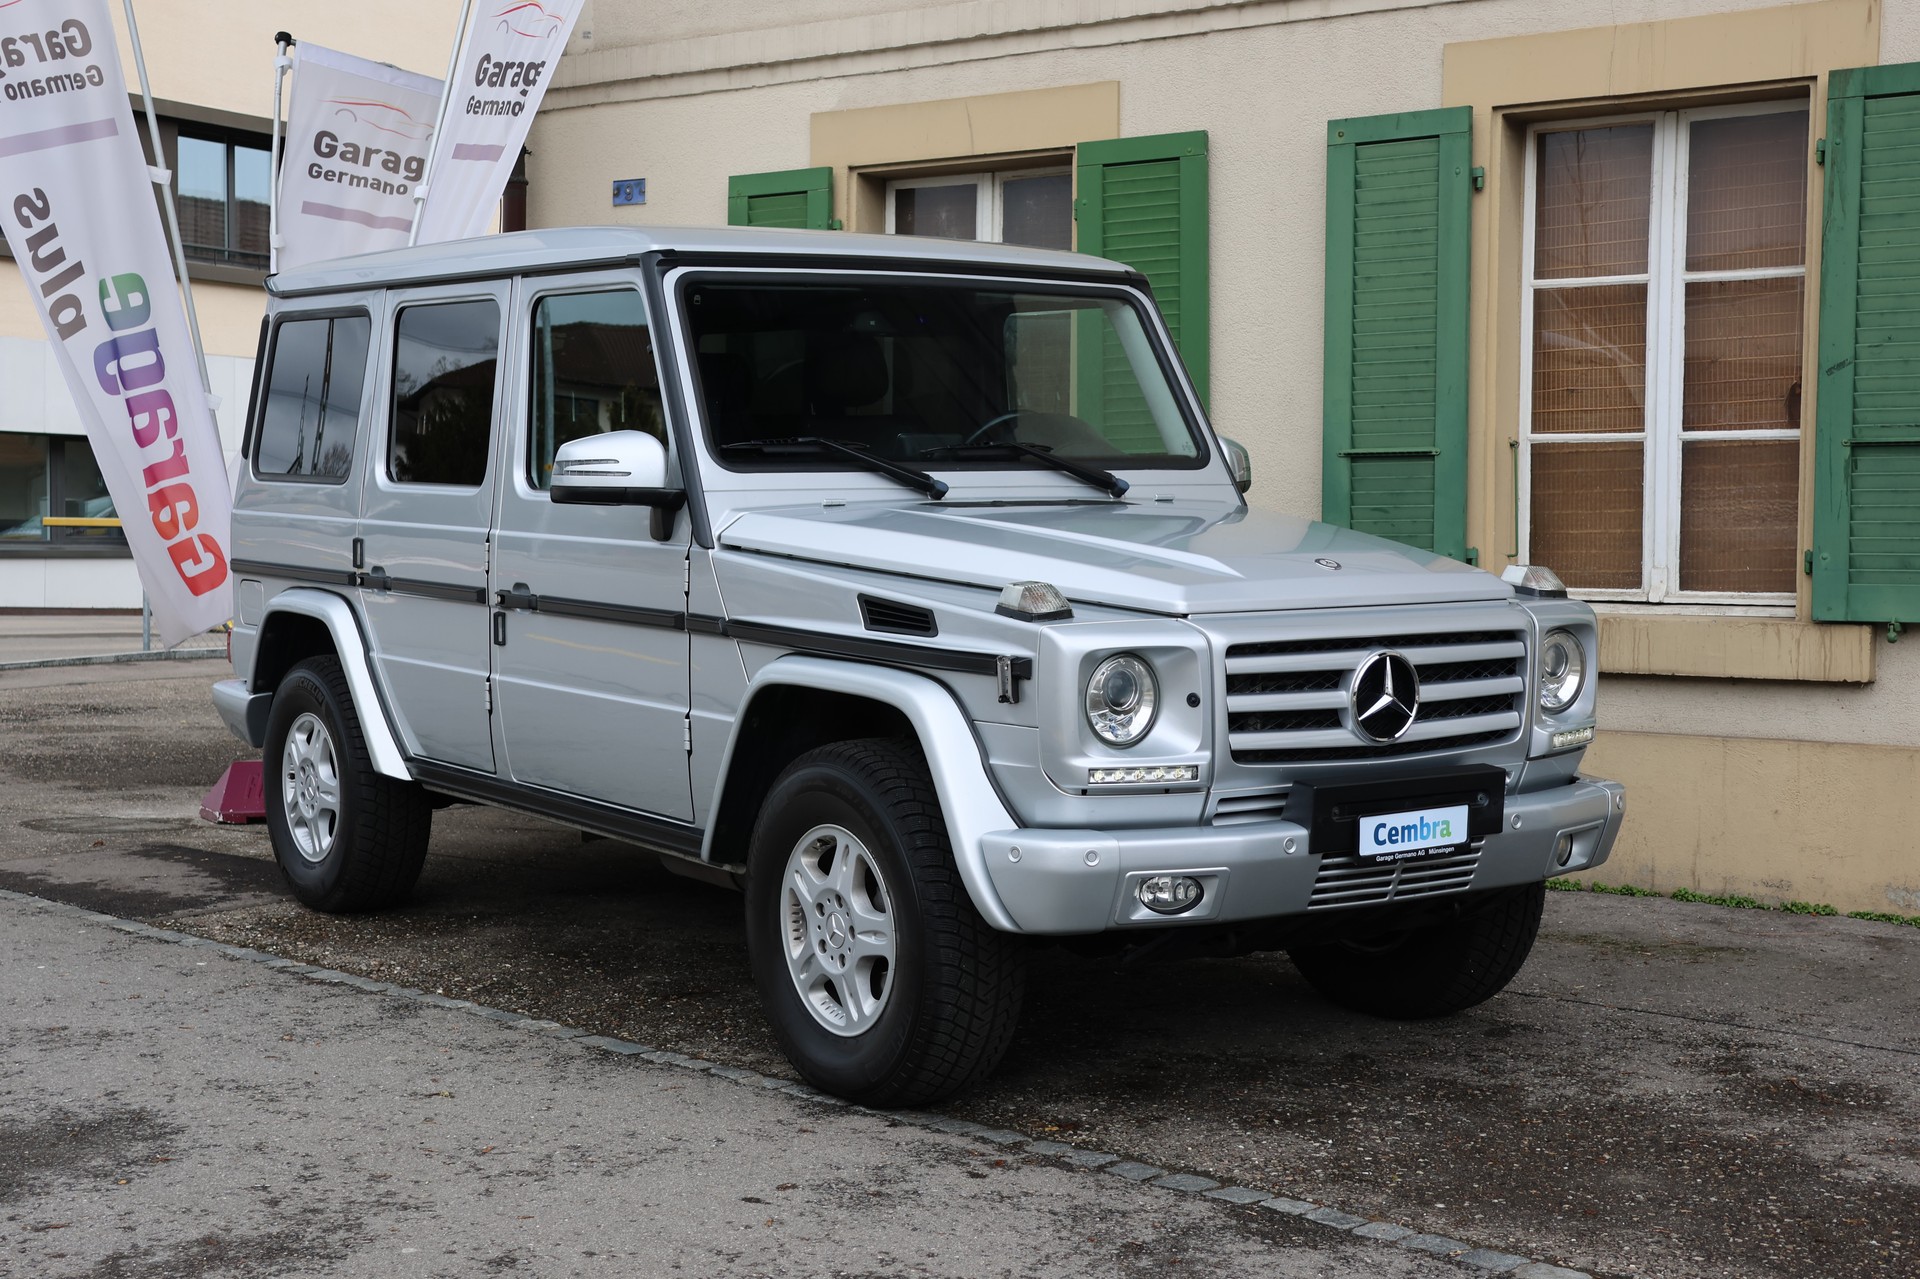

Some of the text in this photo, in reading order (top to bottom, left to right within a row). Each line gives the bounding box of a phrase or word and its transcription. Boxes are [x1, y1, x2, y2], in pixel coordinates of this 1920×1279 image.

[313, 130, 425, 182] Garag
[308, 162, 408, 196] Germano
[294, 677, 325, 706] ICHELIN
[1374, 816, 1452, 846] Cembra
[1376, 854, 1394, 862] Garage
[1428, 846, 1455, 855] Münsingen
